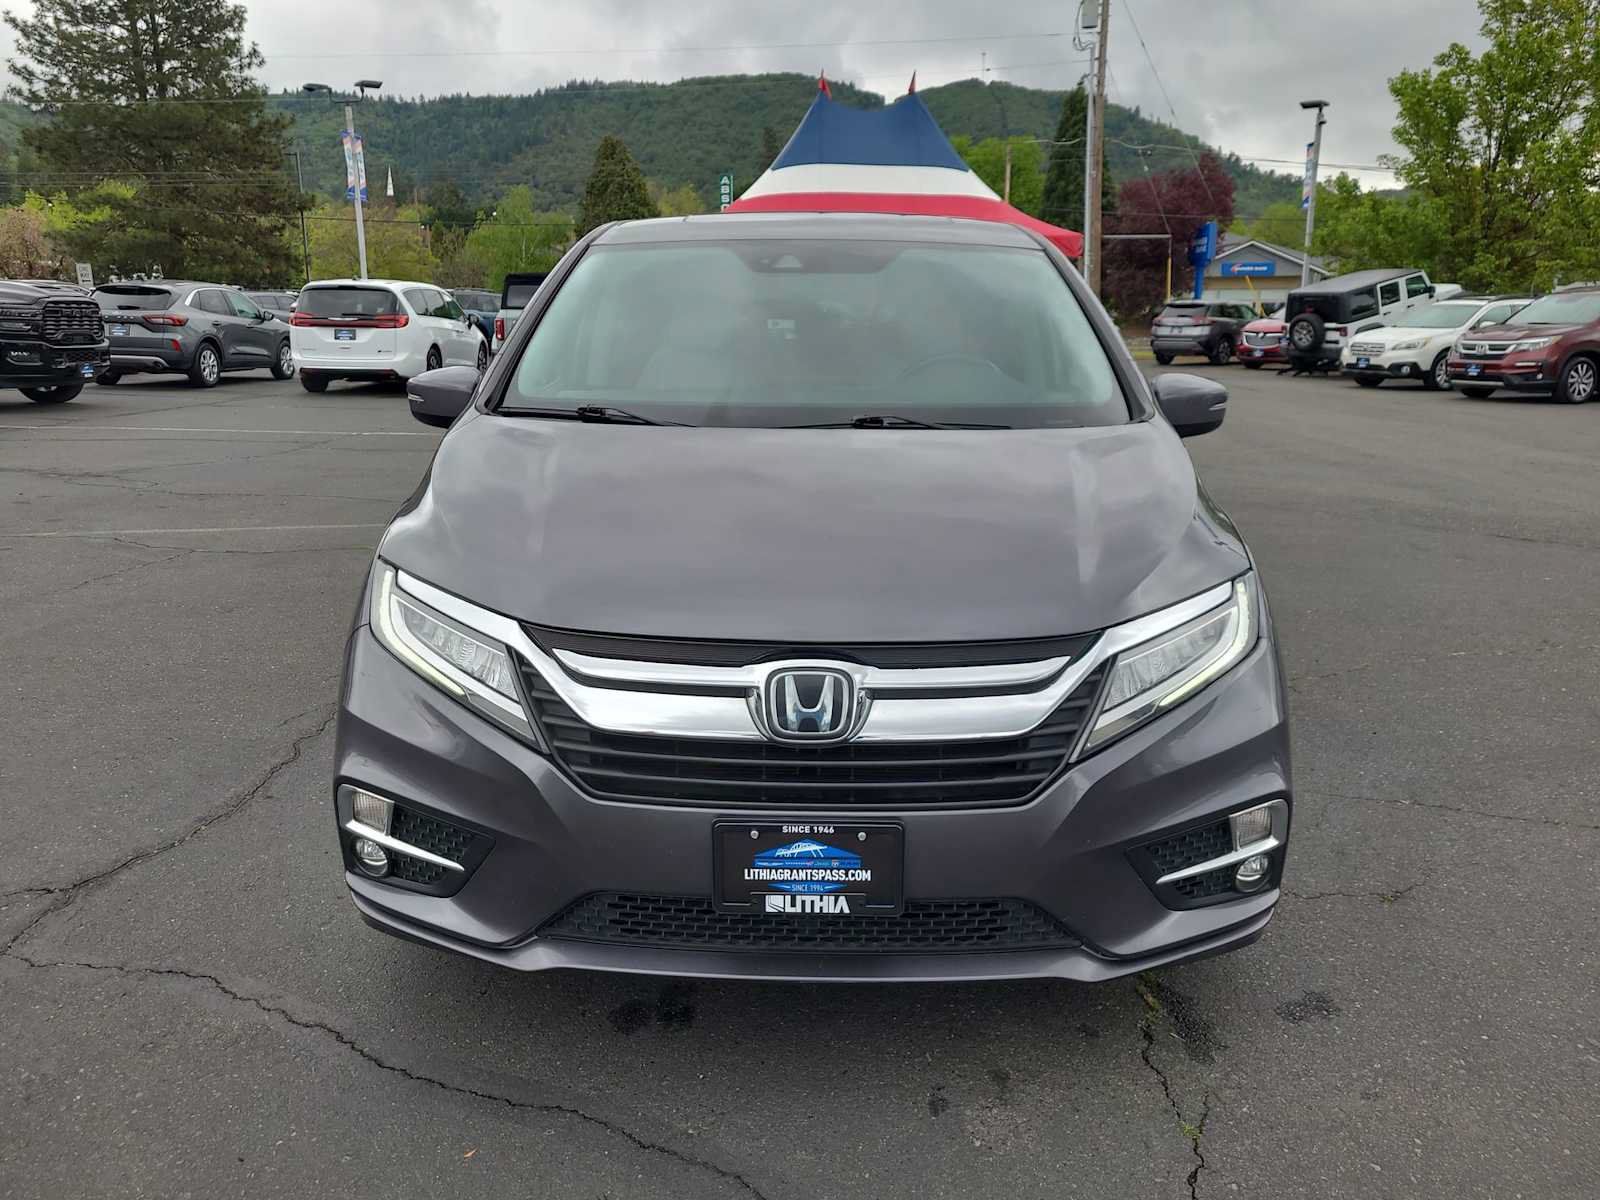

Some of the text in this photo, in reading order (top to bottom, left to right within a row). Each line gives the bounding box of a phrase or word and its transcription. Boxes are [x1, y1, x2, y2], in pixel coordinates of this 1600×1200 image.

[782, 825, 835, 834] SINCE 1946
[744, 868, 871, 882] LITHIAGRANTSPASS.COM
[791, 883, 808, 892] SINCE
[784, 894, 851, 914] LITHIA
